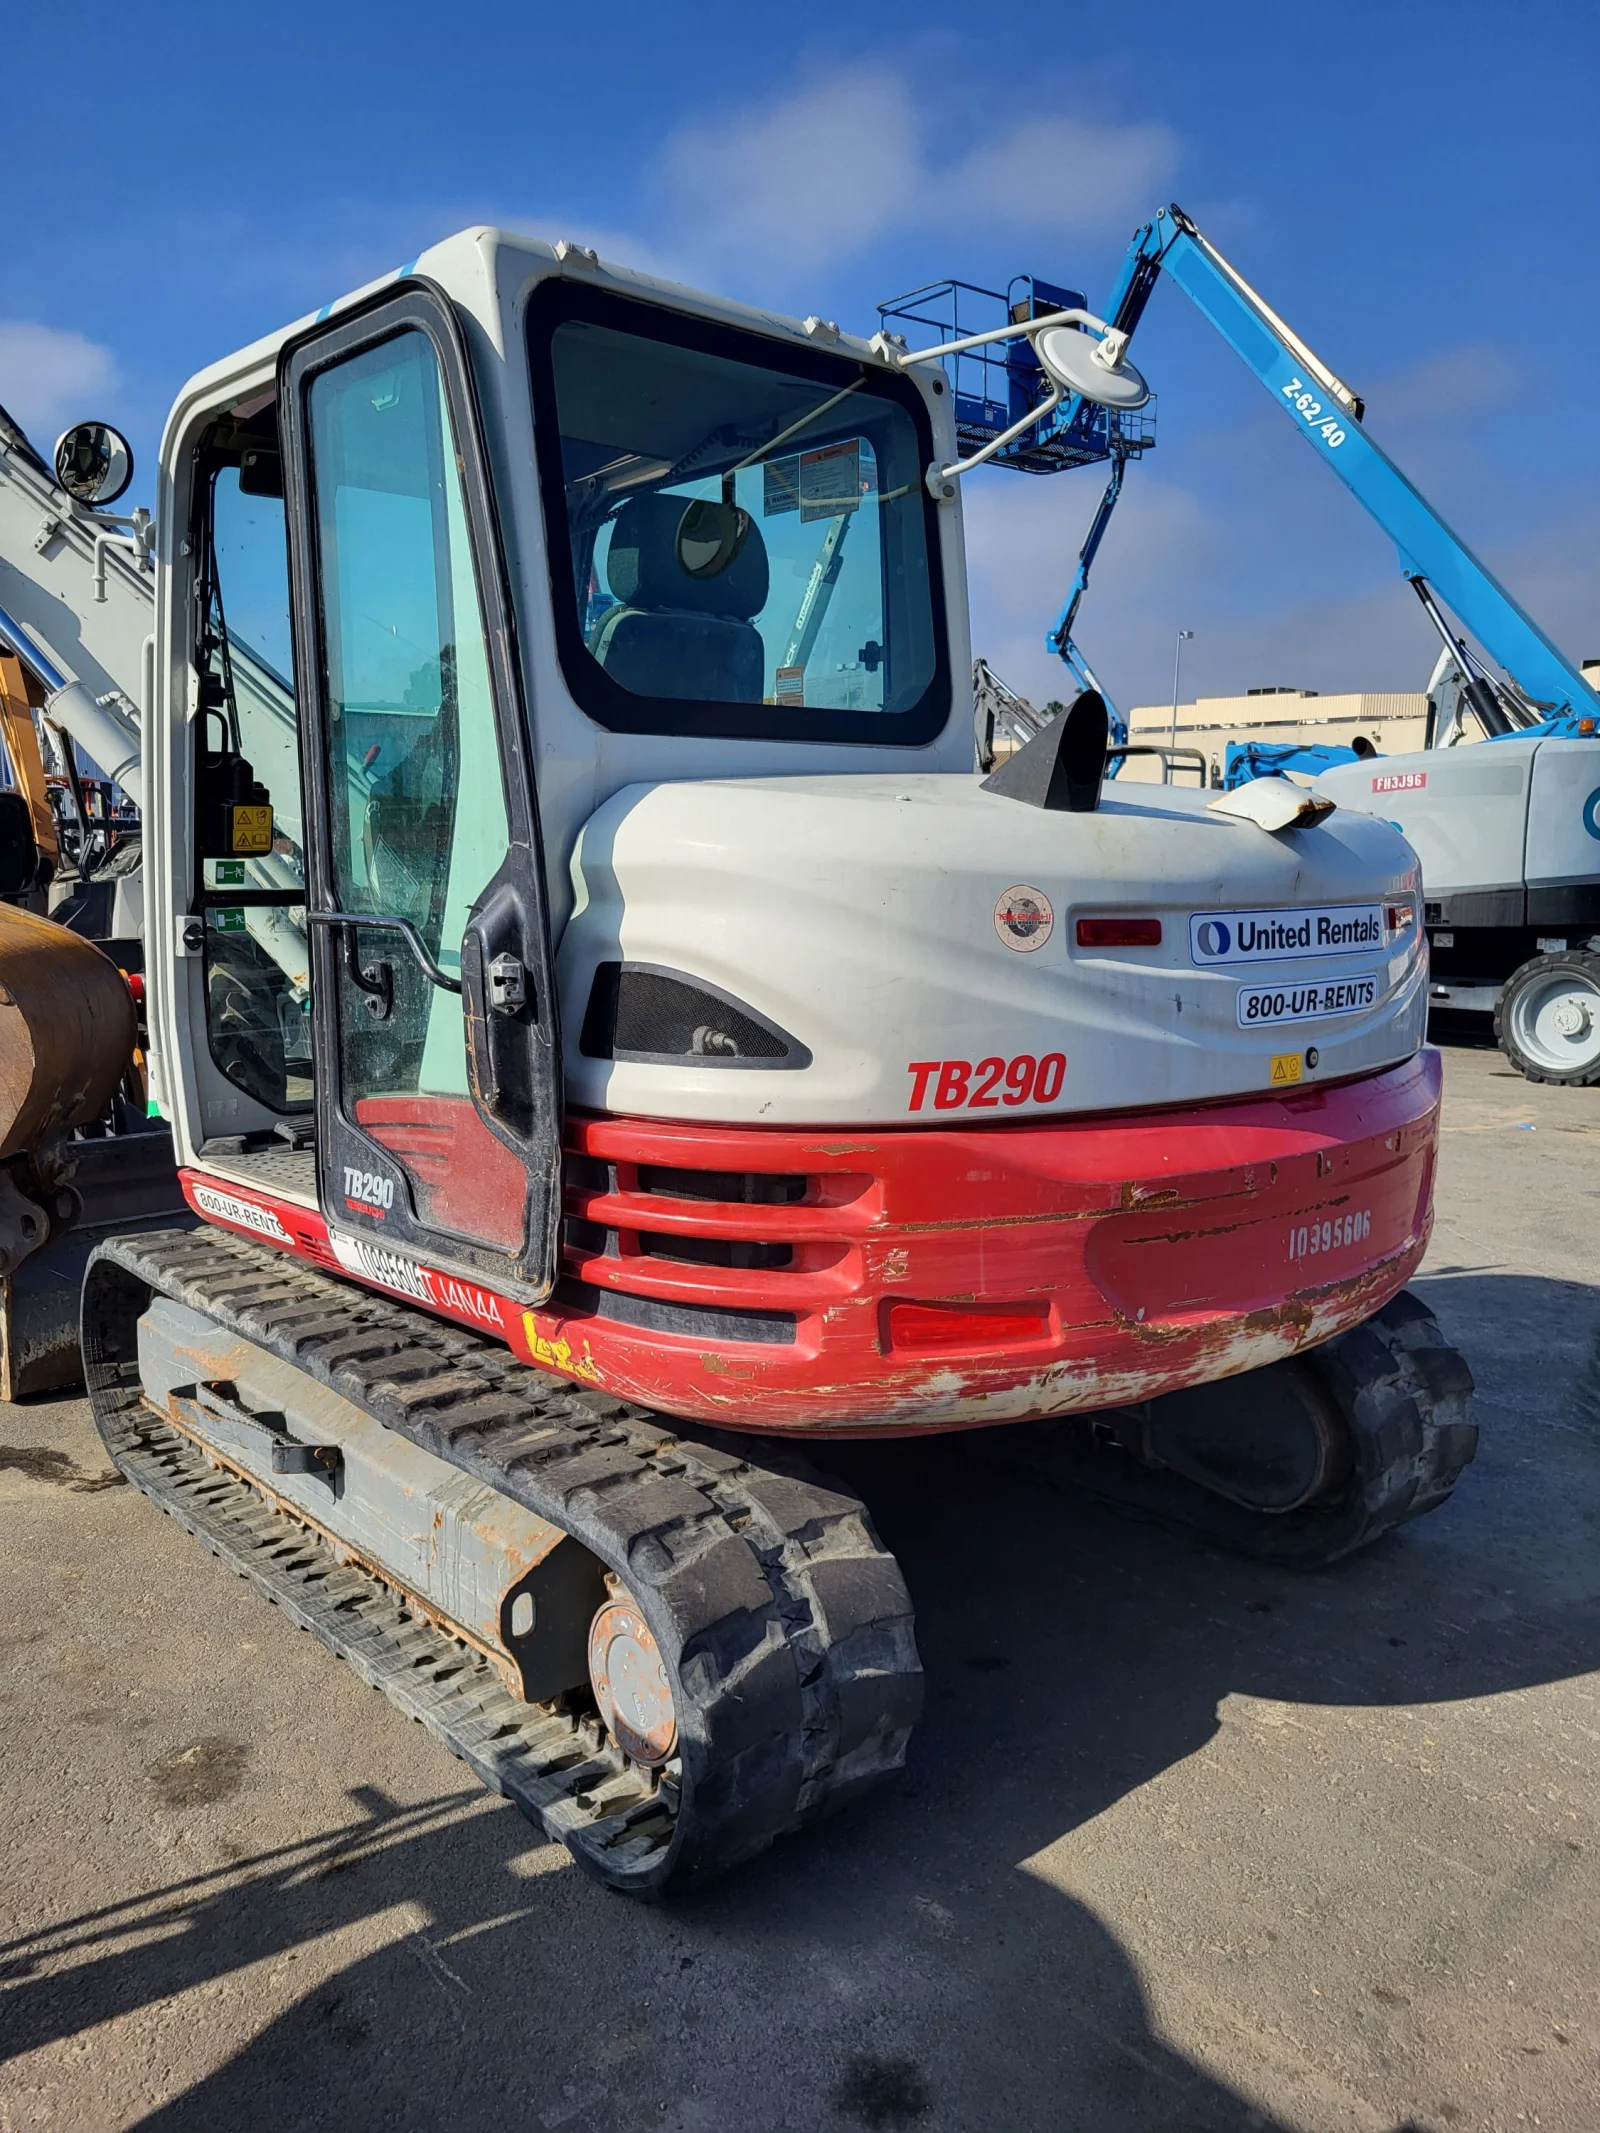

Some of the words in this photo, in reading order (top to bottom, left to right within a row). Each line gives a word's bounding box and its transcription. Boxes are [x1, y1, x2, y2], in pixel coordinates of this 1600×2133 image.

[1281, 376, 1346, 448] Z-62/40
[1238, 919, 1311, 952] United
[1317, 914, 1380, 946] Rentals
[1246, 982, 1375, 1019] 800-UR-RENTS
[907, 1052, 1067, 1112] TB290
[343, 1166, 394, 1209] TB290
[200, 1192, 287, 1237] 800-UR-RENTS
